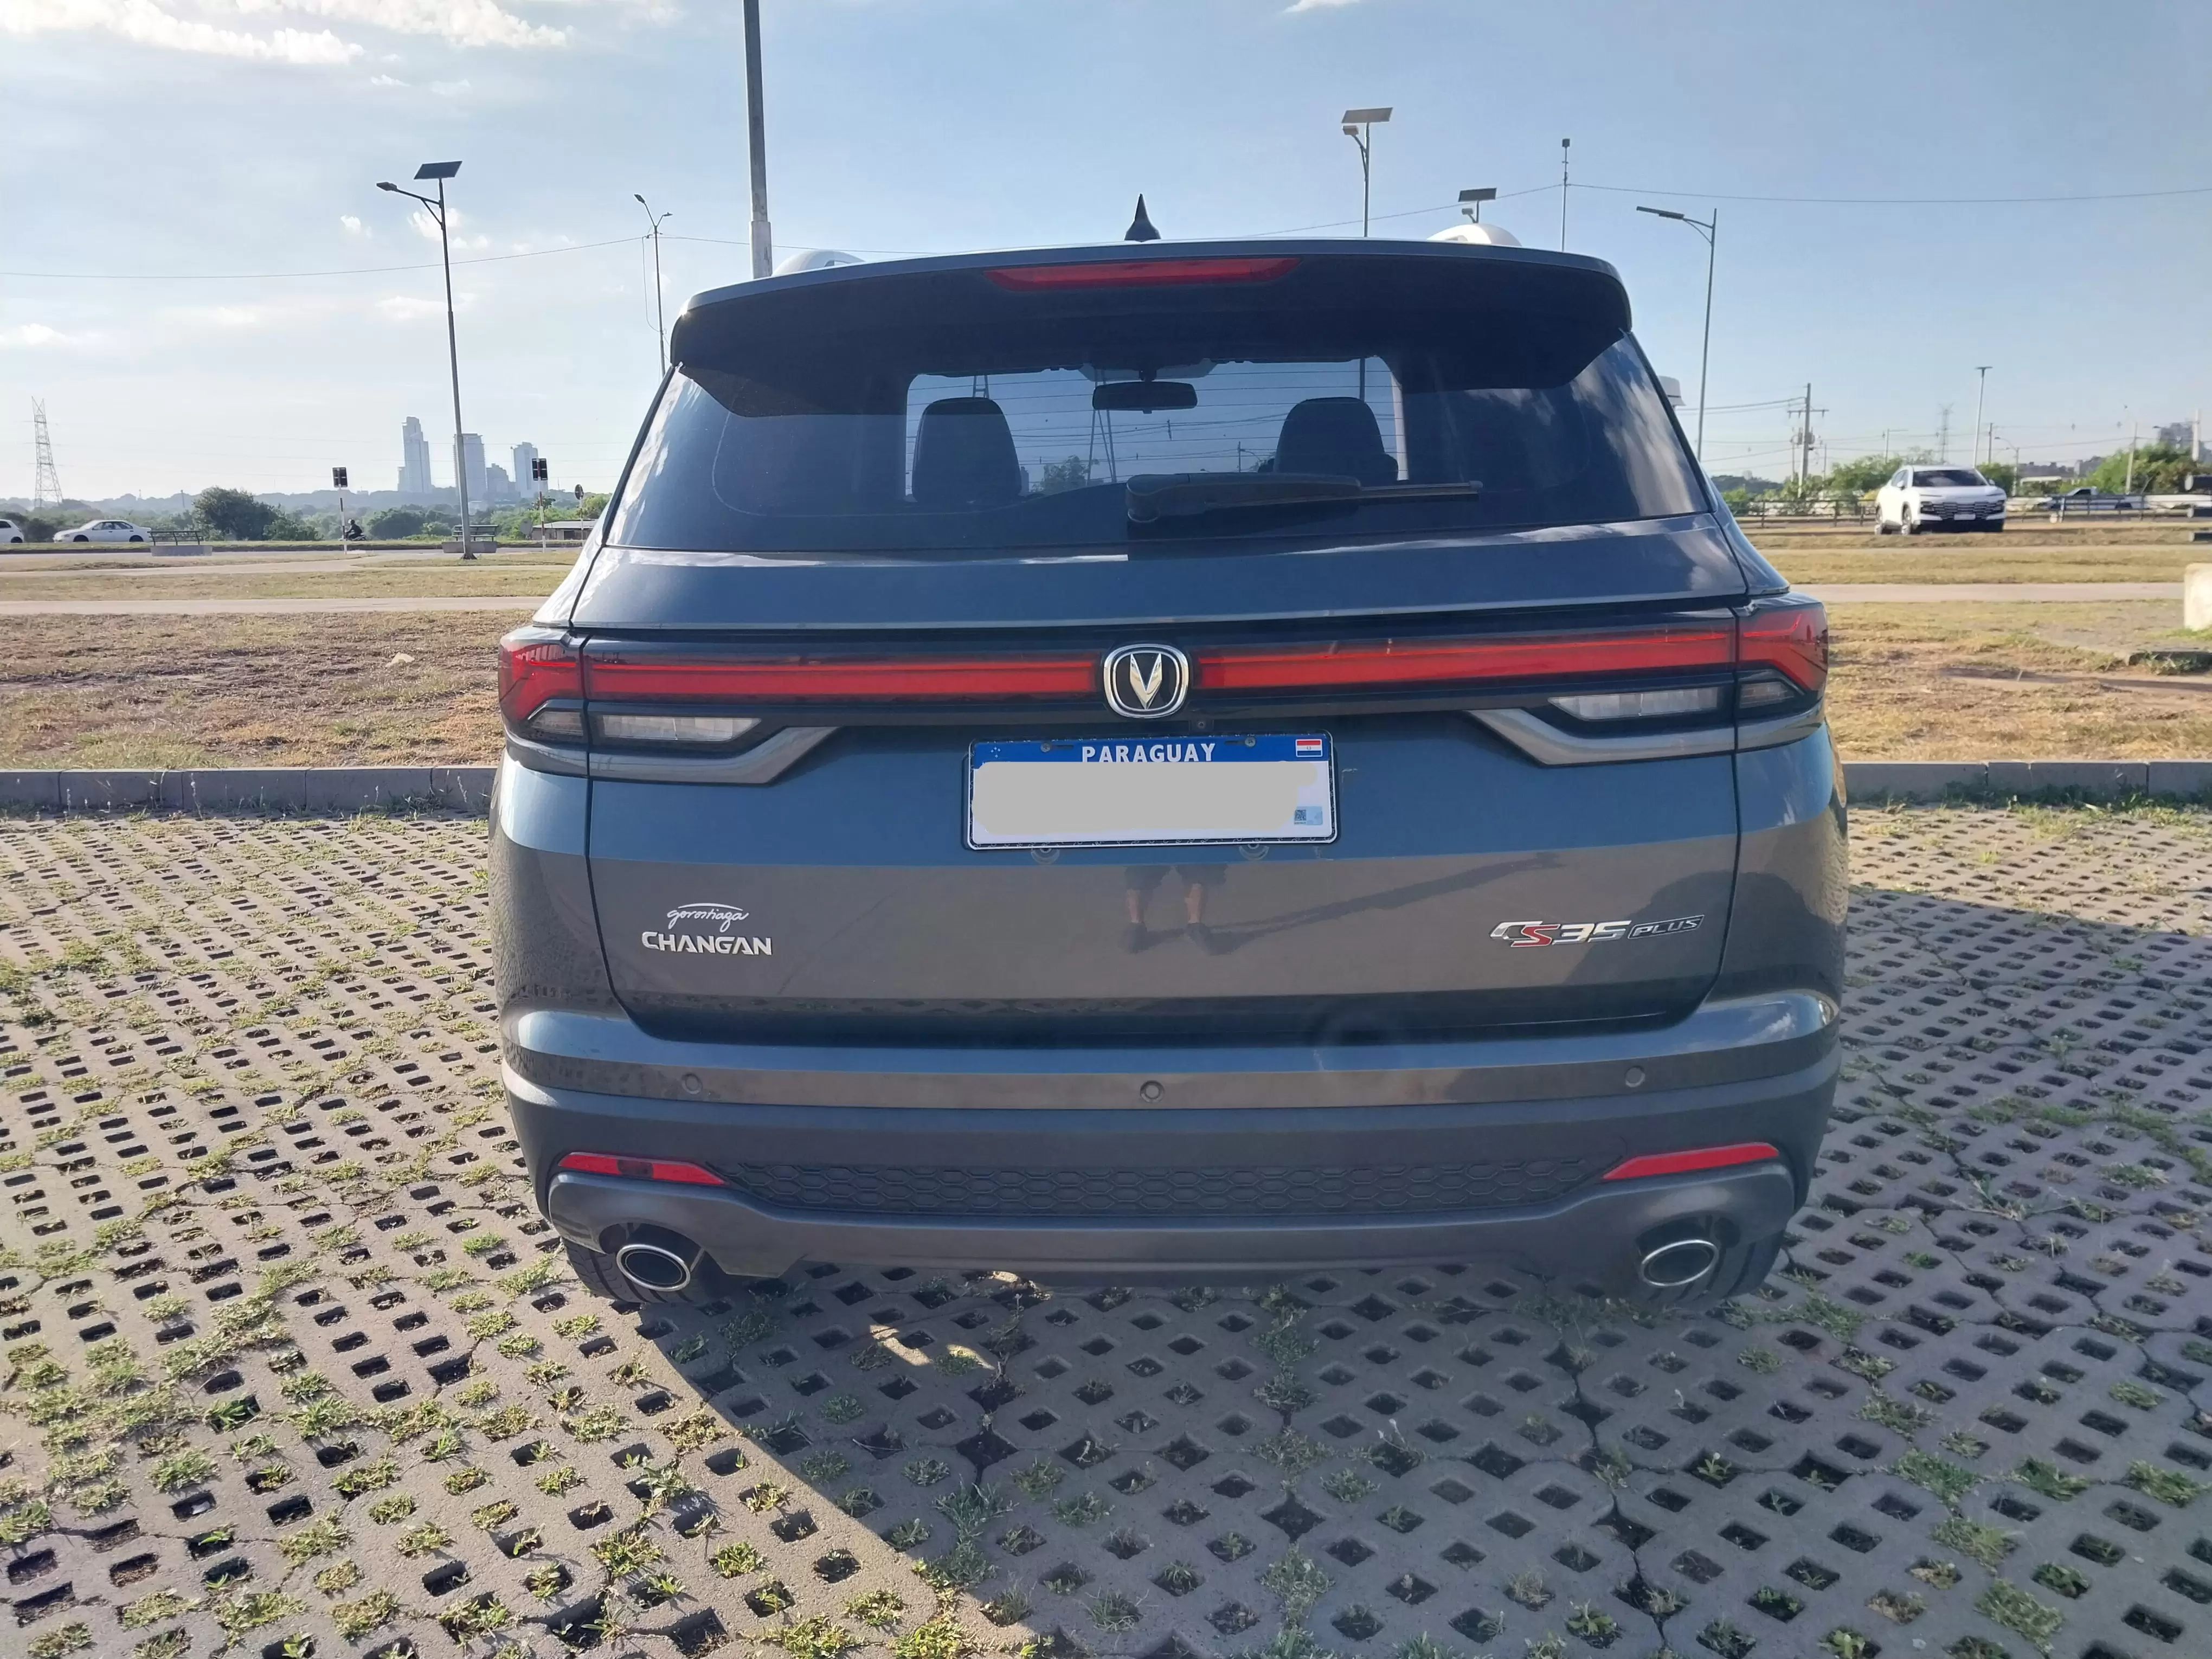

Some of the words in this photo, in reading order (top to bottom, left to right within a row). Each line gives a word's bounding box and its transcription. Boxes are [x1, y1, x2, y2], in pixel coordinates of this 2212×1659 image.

[1082, 743, 1216, 762] PARAGUAY
[641, 931, 773, 956] CHANGAN
[1489, 919, 1632, 948] CS35
[1632, 918, 1699, 937] PLUS
